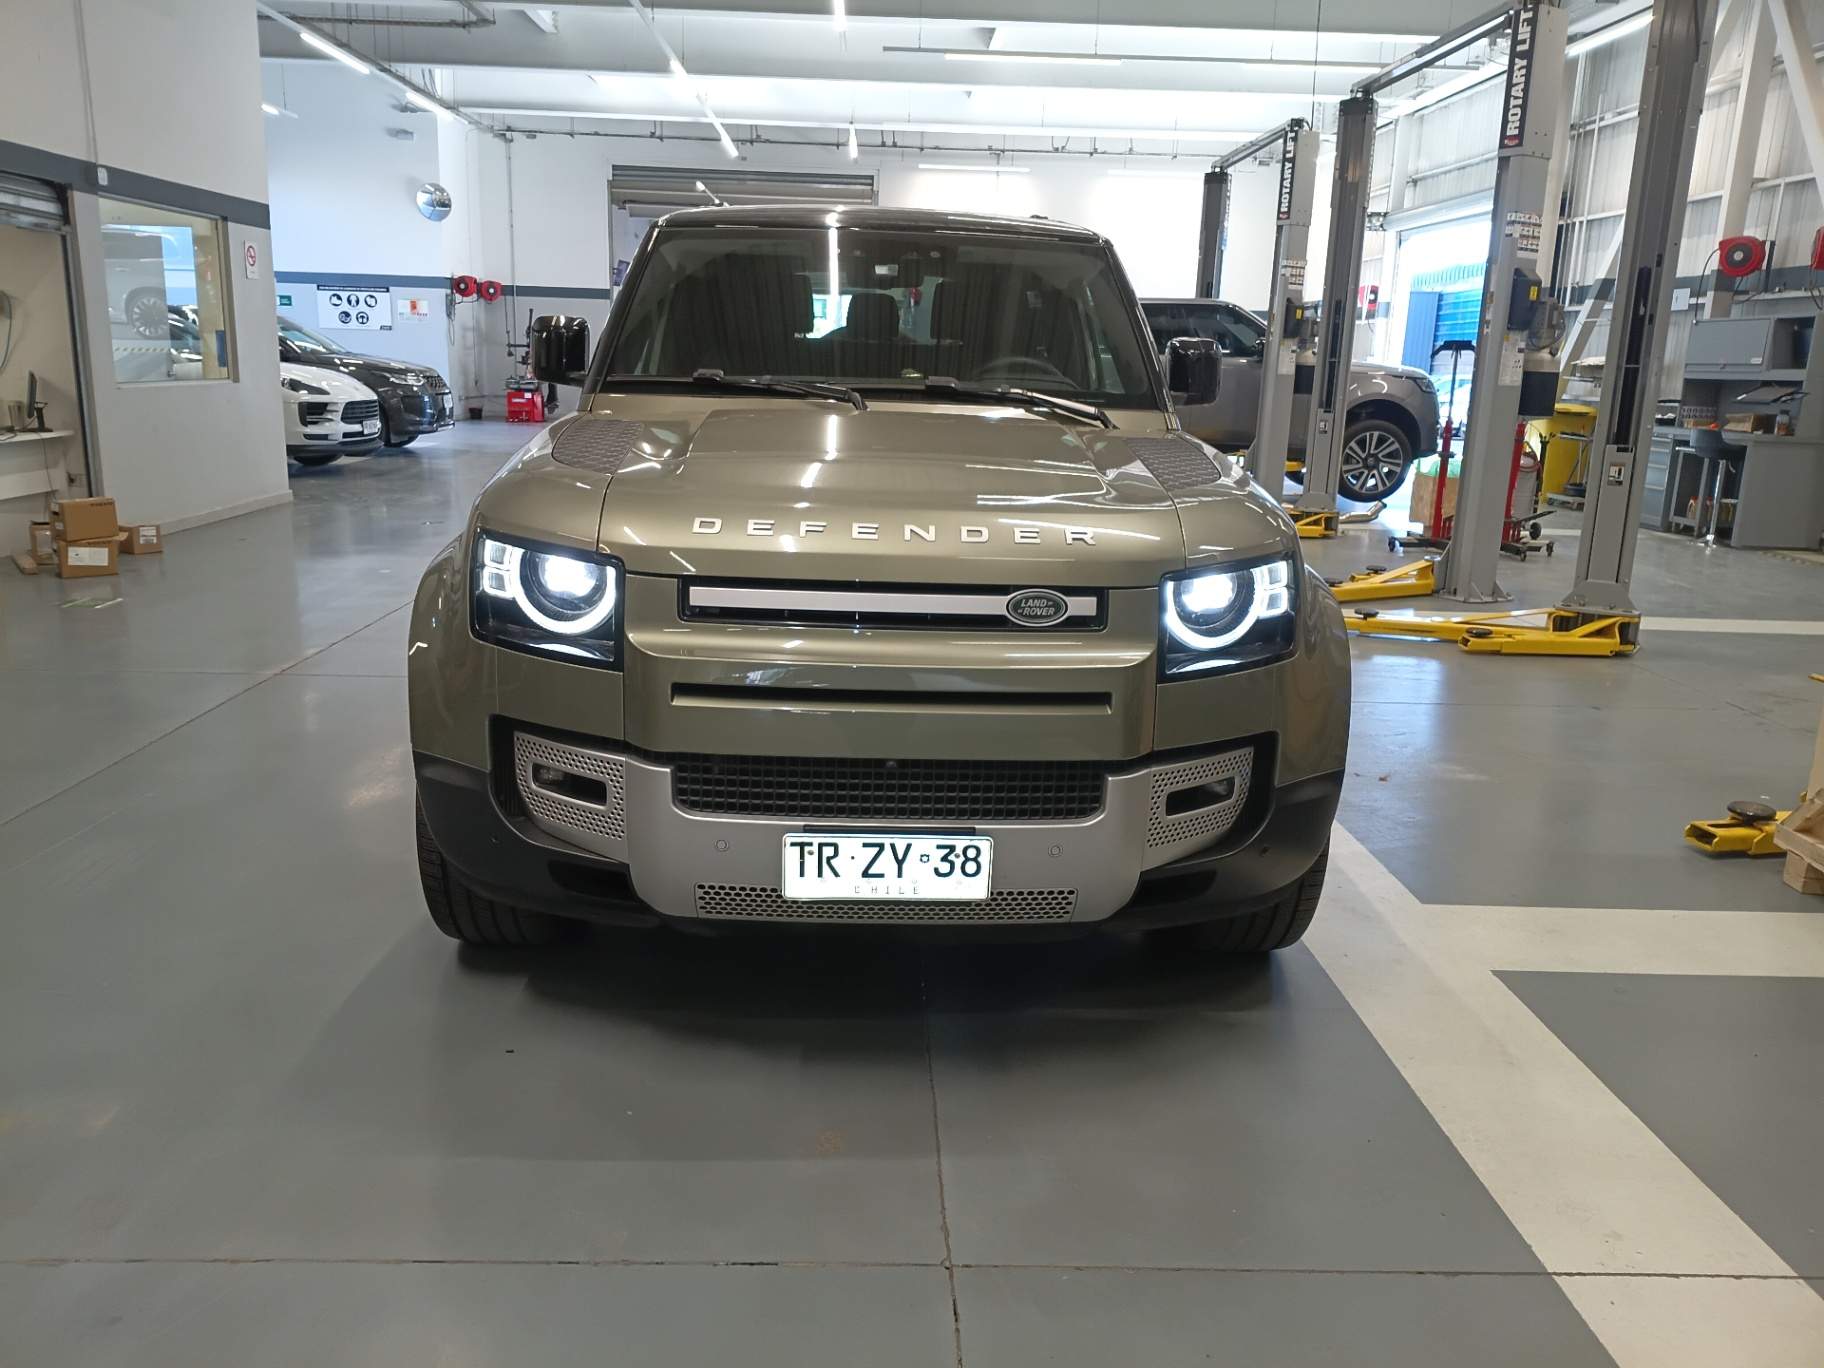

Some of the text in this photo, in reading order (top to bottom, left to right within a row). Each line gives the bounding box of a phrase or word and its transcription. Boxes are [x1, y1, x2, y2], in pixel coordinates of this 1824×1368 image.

[1506, 10, 1534, 136] ROTARY LIFT
[1280, 131, 1296, 212] ROTARY LIFT
[691, 517, 1097, 545] DEFENDER
[854, 885, 920, 895] CHILE
